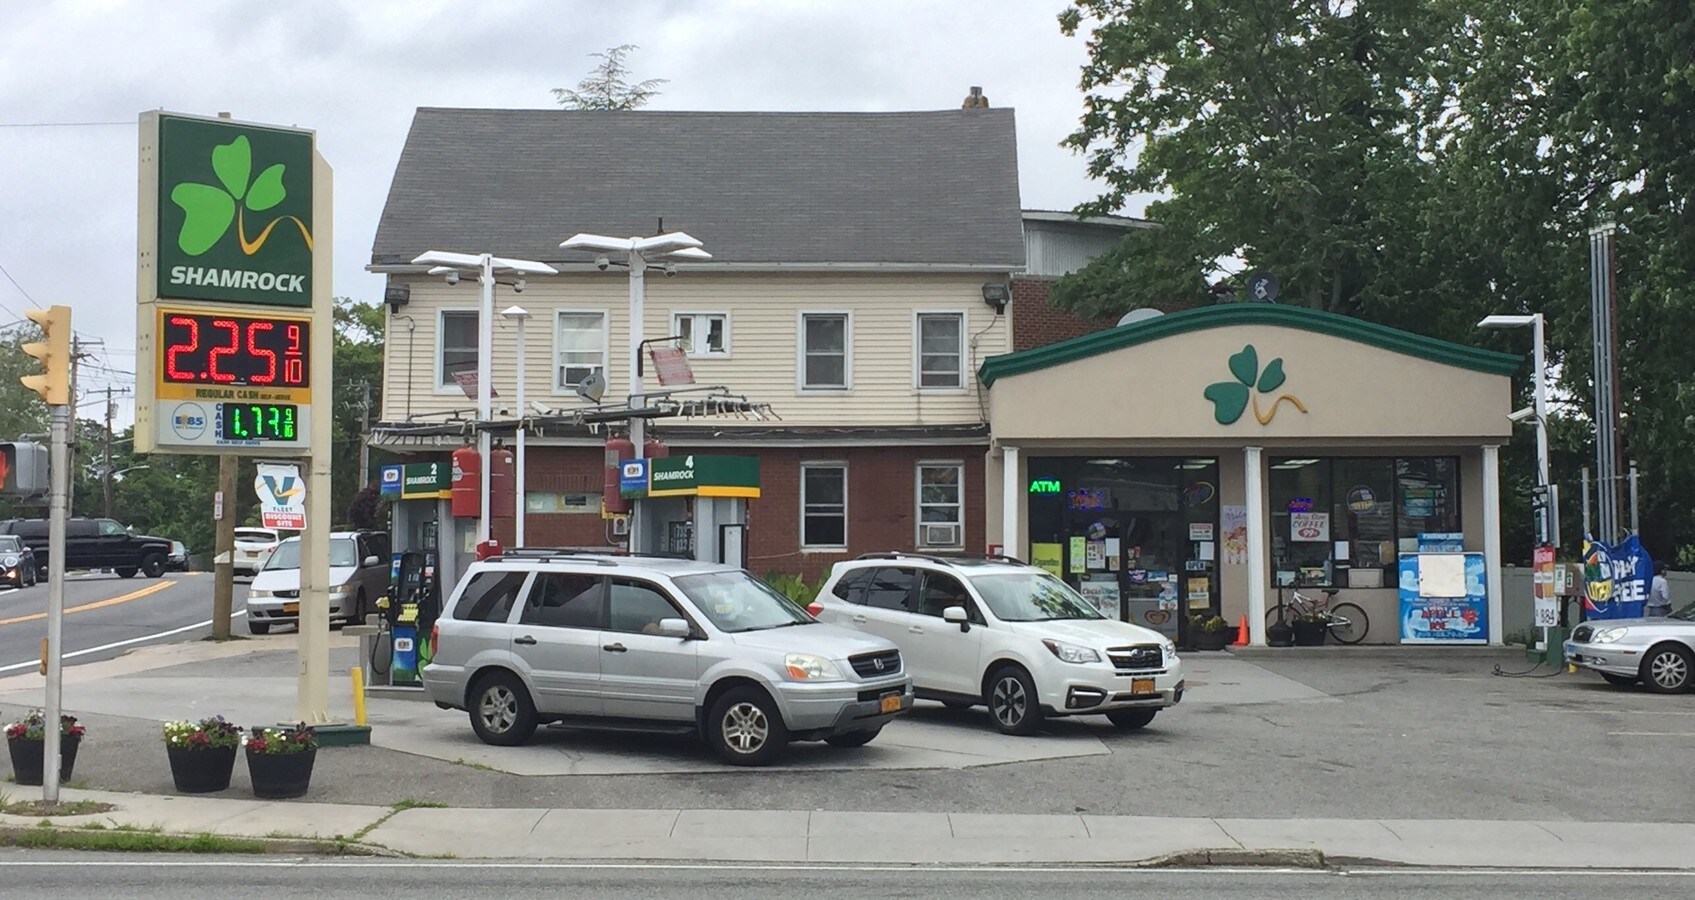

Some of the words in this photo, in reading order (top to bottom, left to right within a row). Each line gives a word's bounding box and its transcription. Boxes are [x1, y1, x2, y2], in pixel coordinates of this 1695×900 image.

[170, 265, 306, 294] SHAMROCK
[167, 317, 276, 383] 2.25
[195, 388, 235, 399] REGULAR
[236, 389, 260, 400] CASH
[685, 454, 694, 469] 4
[430, 462, 438, 475] 2
[405, 475, 438, 485] SHAMROCK
[653, 469, 695, 481] SHAMROCK
[1029, 480, 1061, 493] ATM
[265, 512, 303, 521] DISCOUNT
[275, 519, 294, 527] SITE
[1292, 520, 1326, 529] COFFEE
[1421, 606, 1459, 619] APPLE
